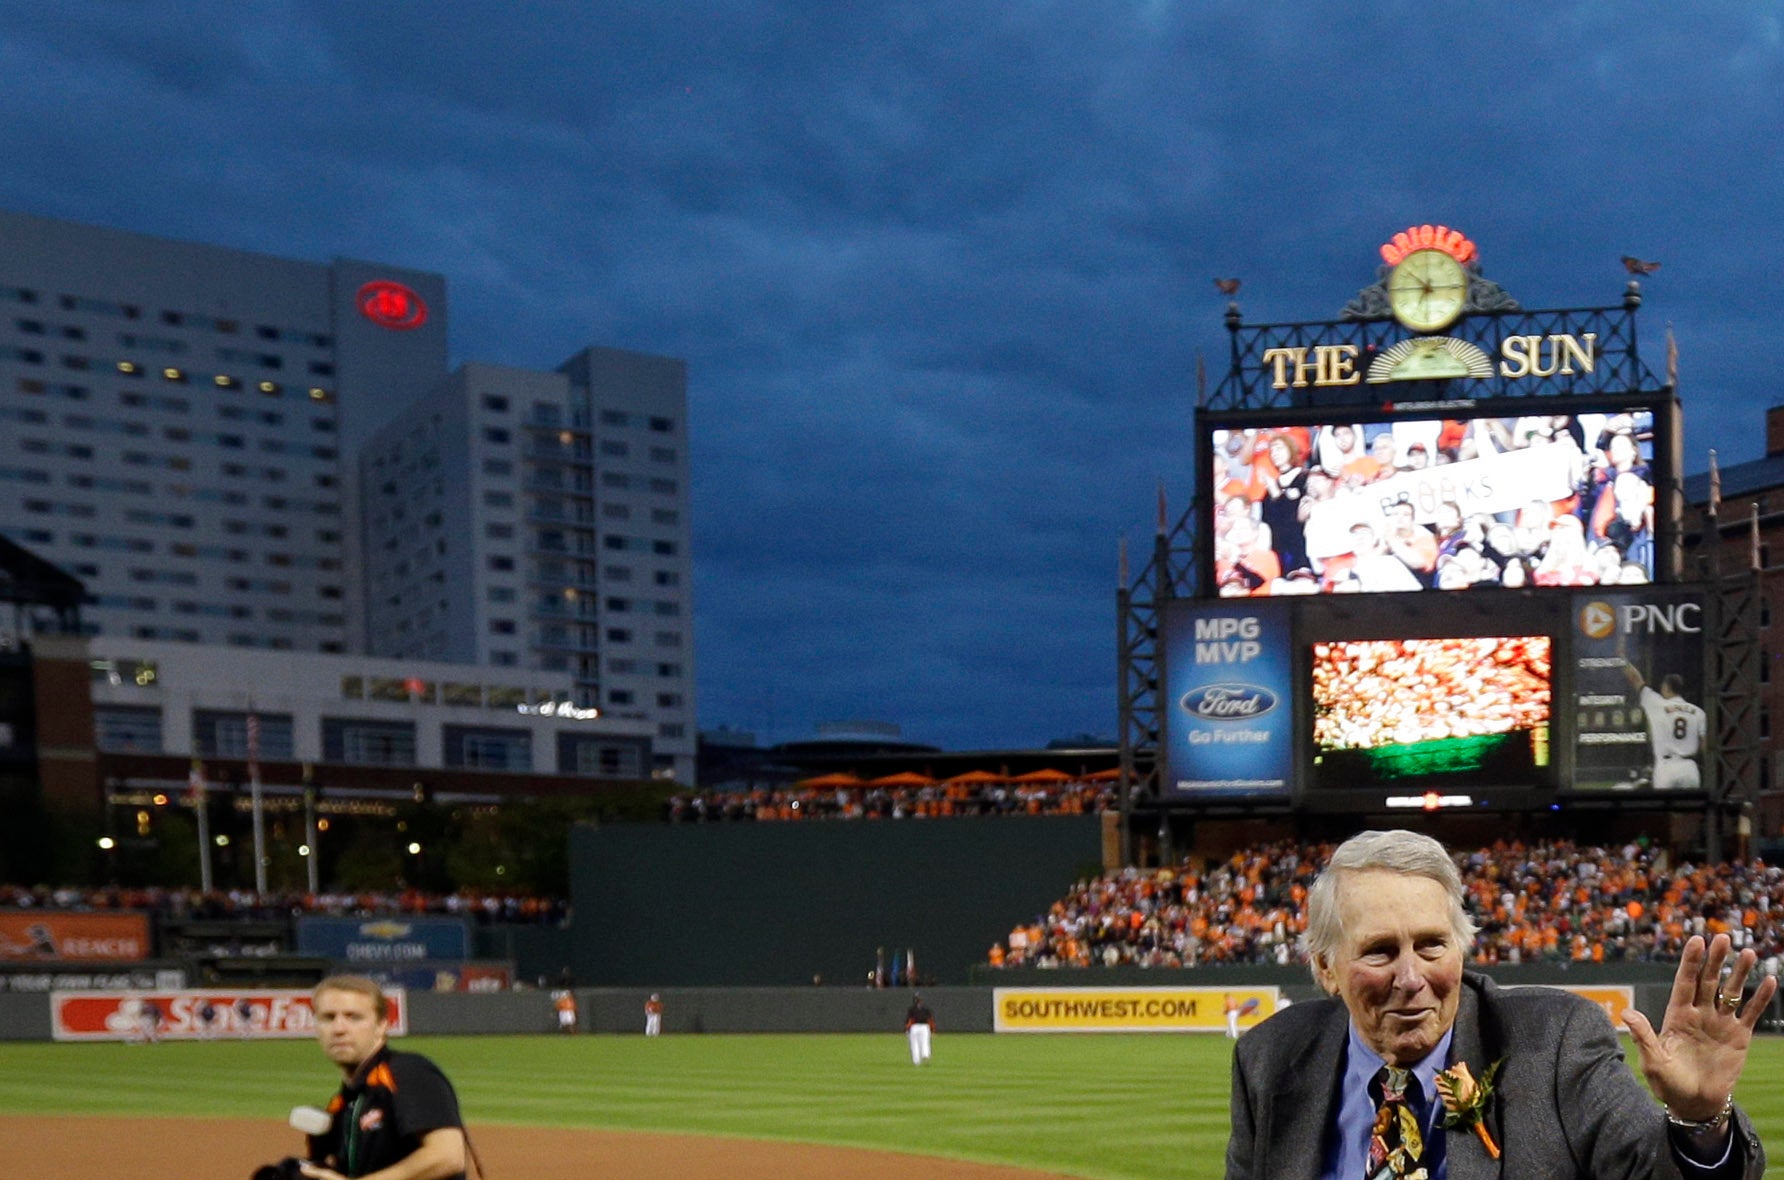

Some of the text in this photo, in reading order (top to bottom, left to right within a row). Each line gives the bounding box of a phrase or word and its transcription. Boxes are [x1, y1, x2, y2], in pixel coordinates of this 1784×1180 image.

[1380, 224, 1478, 266] ORIOLES
[1263, 333, 1597, 389] THE SUN
[1195, 617, 1261, 641] MPG
[1622, 602, 1702, 634] PNC
[1196, 641, 1262, 664] MVP
[1198, 687, 1261, 716] Ford
[1188, 728, 1270, 745] Go Further
[1673, 716, 1688, 740] 8
[1005, 1000, 1197, 1018] SOUTHWEST.COM
